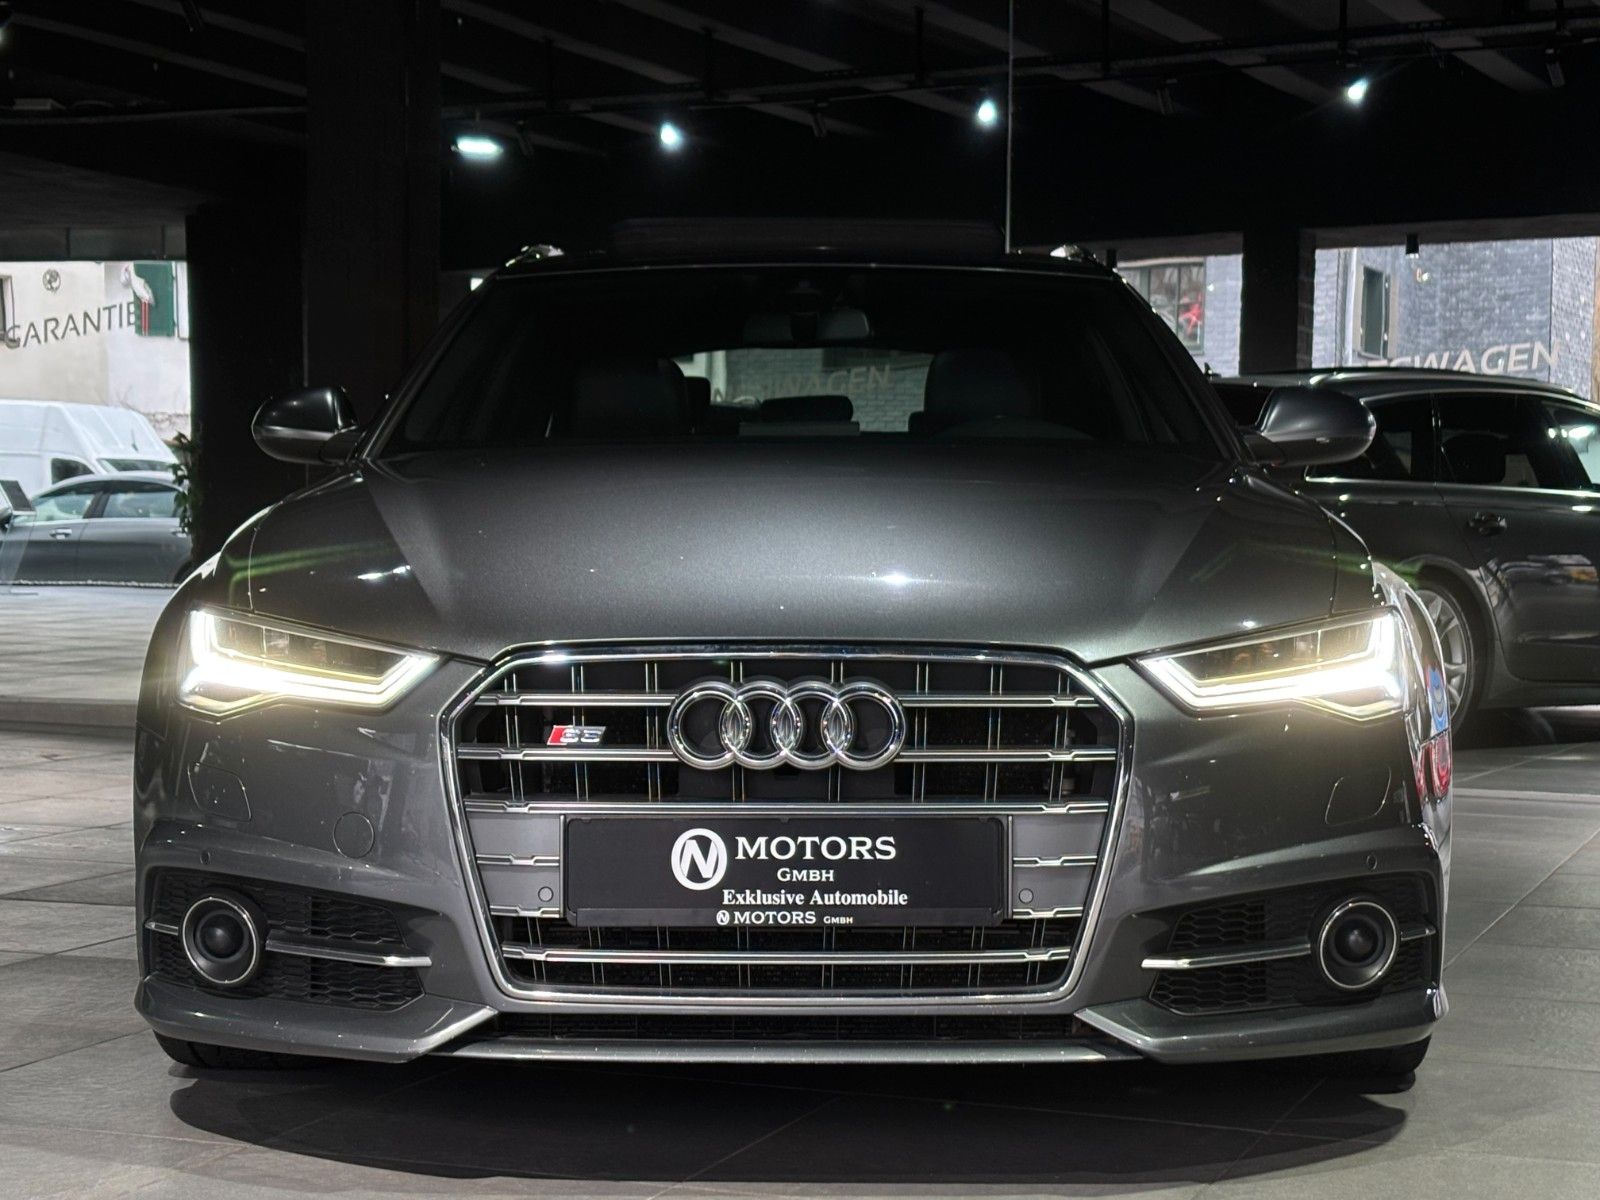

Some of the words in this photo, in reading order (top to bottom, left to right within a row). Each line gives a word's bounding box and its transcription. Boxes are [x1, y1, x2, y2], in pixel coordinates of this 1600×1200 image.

[735, 836, 897, 860] MOTORS
[777, 868, 835, 882] GMBH
[722, 889, 804, 906] Exklusive
[810, 889, 908, 906] Automobile
[734, 911, 816, 924] MOTORS
[823, 916, 853, 925] GMBH
